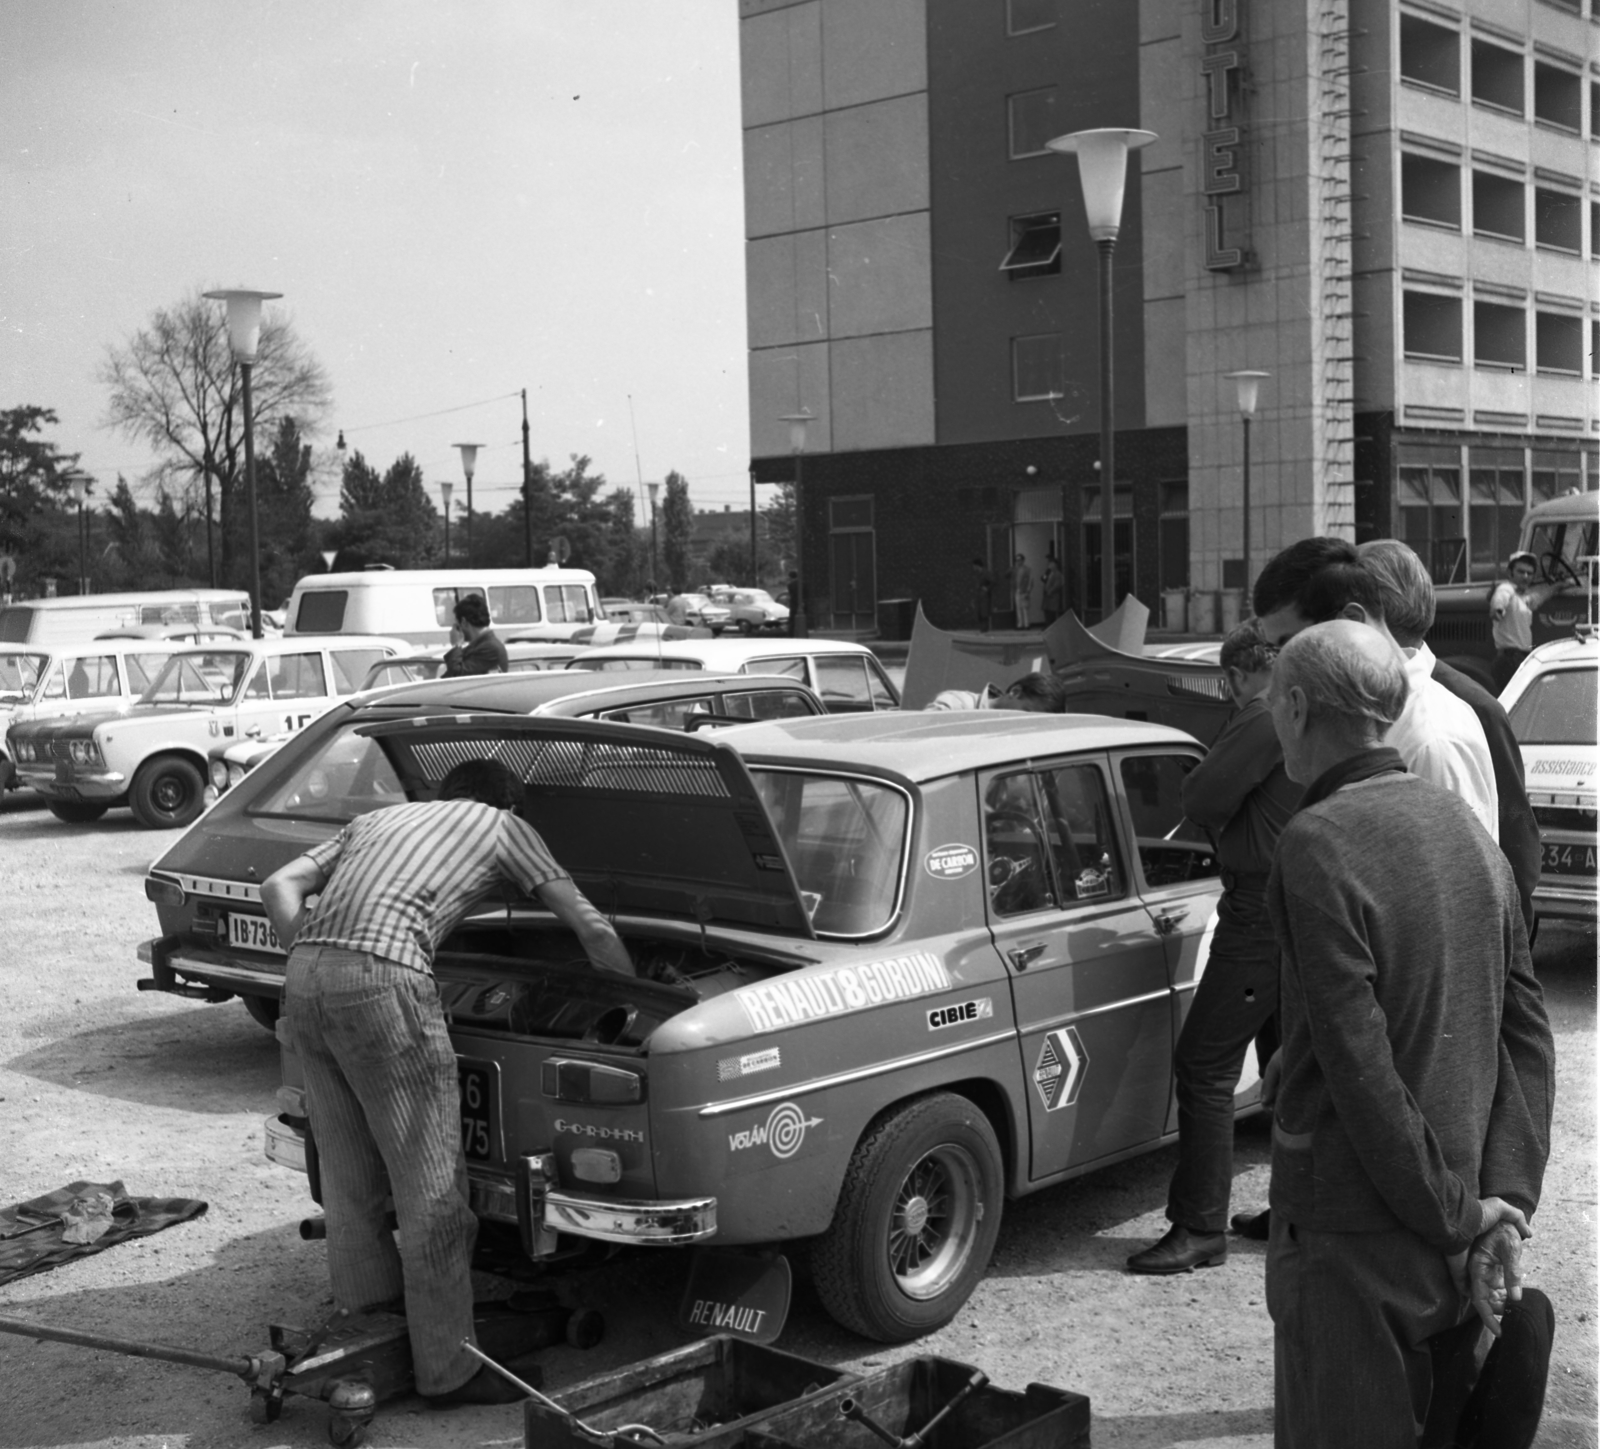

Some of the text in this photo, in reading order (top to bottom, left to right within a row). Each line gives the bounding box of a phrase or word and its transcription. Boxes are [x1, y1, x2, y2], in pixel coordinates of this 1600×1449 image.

[1530, 758, 1597, 776] assistance
[234, 918, 284, 950] IB-73-6
[740, 952, 950, 1031] RENAULT 8 GORDINI
[463, 1117, 489, 1155] 75
[554, 1118, 644, 1143] GORDINI
[729, 1124, 768, 1152] VOLÁN
[689, 1299, 767, 1333] RENAULT
